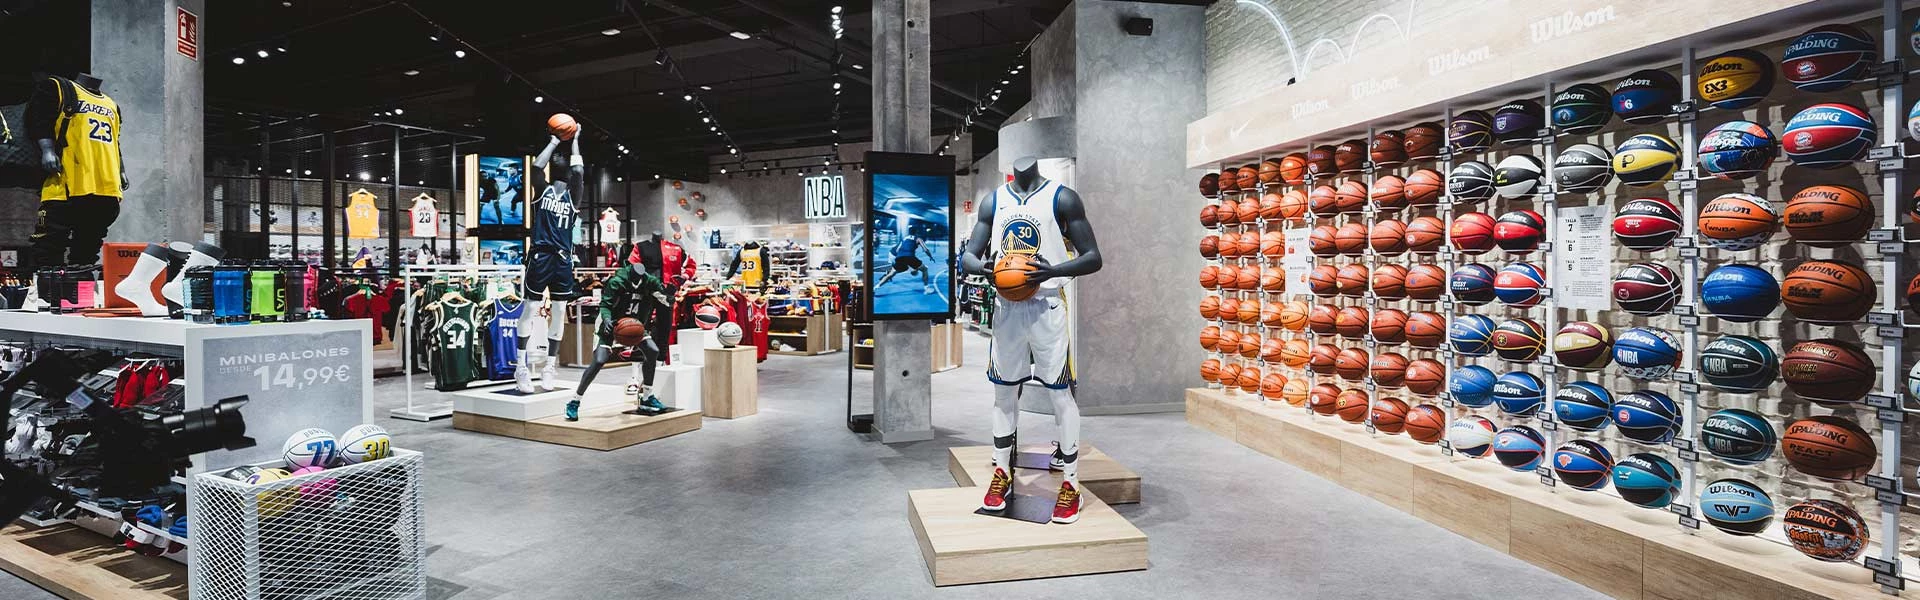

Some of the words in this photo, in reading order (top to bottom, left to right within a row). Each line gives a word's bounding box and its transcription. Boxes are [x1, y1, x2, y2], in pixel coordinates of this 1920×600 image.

[1529, 5, 1616, 43] Wilson
[1427, 45, 1490, 77] Wilson
[1351, 77, 1398, 99] Wilson
[1292, 100, 1328, 120] Wilson
[89, 118, 113, 142] 23
[541, 197, 571, 215] MAVS
[805, 176, 846, 219] NBA
[1705, 202, 1751, 215] Wilson
[419, 212, 431, 224] 23
[556, 213, 570, 229] 77
[1018, 226, 1032, 238] 30
[742, 260, 755, 270] 33
[447, 330, 466, 349] 34
[503, 328, 513, 337] 34
[219, 347, 350, 366] MINIBALONES
[1622, 350, 1639, 364] NBA
[1709, 358, 1728, 373] NBA
[219, 366, 251, 374] DESDE
[253, 363, 350, 391] 14,99€
[1707, 418, 1748, 435] Wilson
[1790, 425, 1848, 444] SPALDING
[307, 439, 334, 466] 77
[363, 438, 389, 461] 30
[1715, 437, 1732, 453] NBA
[1790, 443, 1834, 457] REACT
[1710, 483, 1755, 498] Wilson
[1786, 510, 1837, 528] SPALDING
